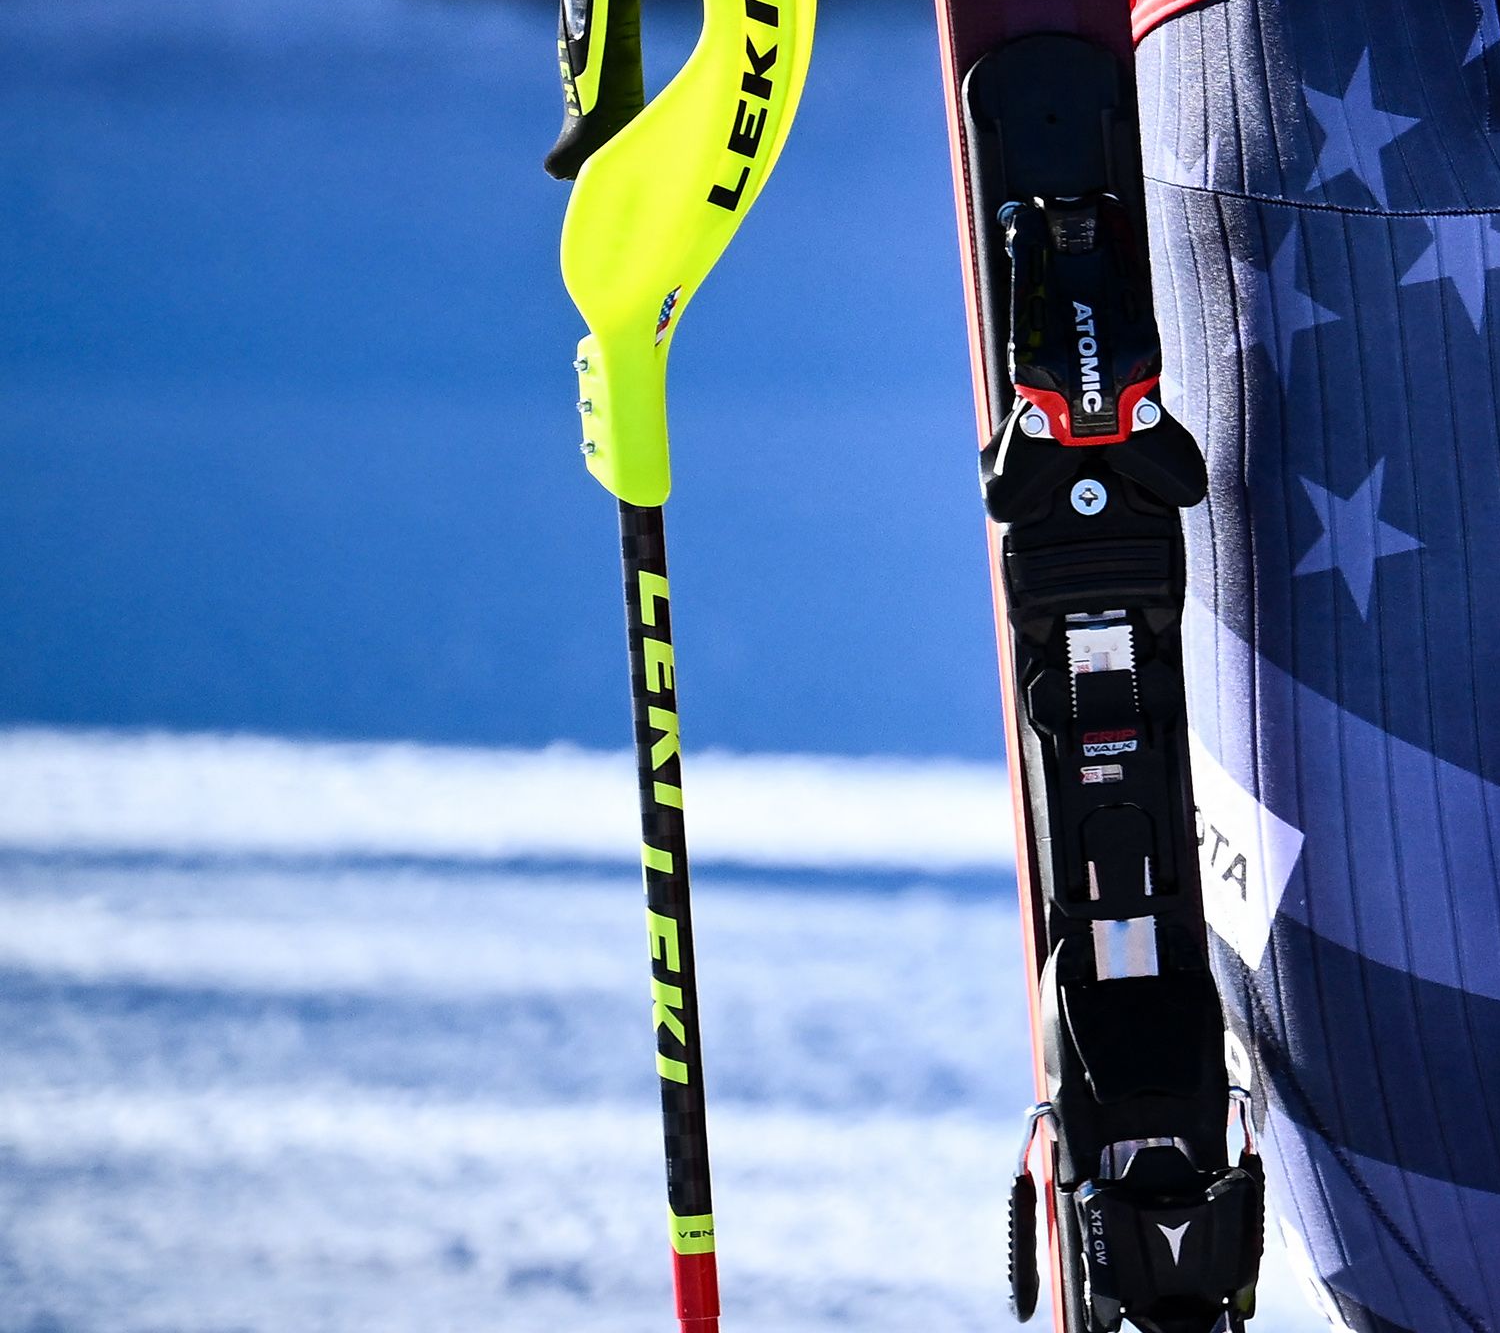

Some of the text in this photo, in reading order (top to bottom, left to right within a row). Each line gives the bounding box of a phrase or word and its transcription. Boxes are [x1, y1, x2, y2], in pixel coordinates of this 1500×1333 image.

[1071, 300, 1103, 414] ATOMIC
[638, 569, 683, 811] LEKI
[1083, 742, 1138, 755] WALK
[642, 841, 690, 1086] LEKI
[678, 1228, 714, 1239] VEN
[1091, 1209, 1108, 1266] X12 GW
